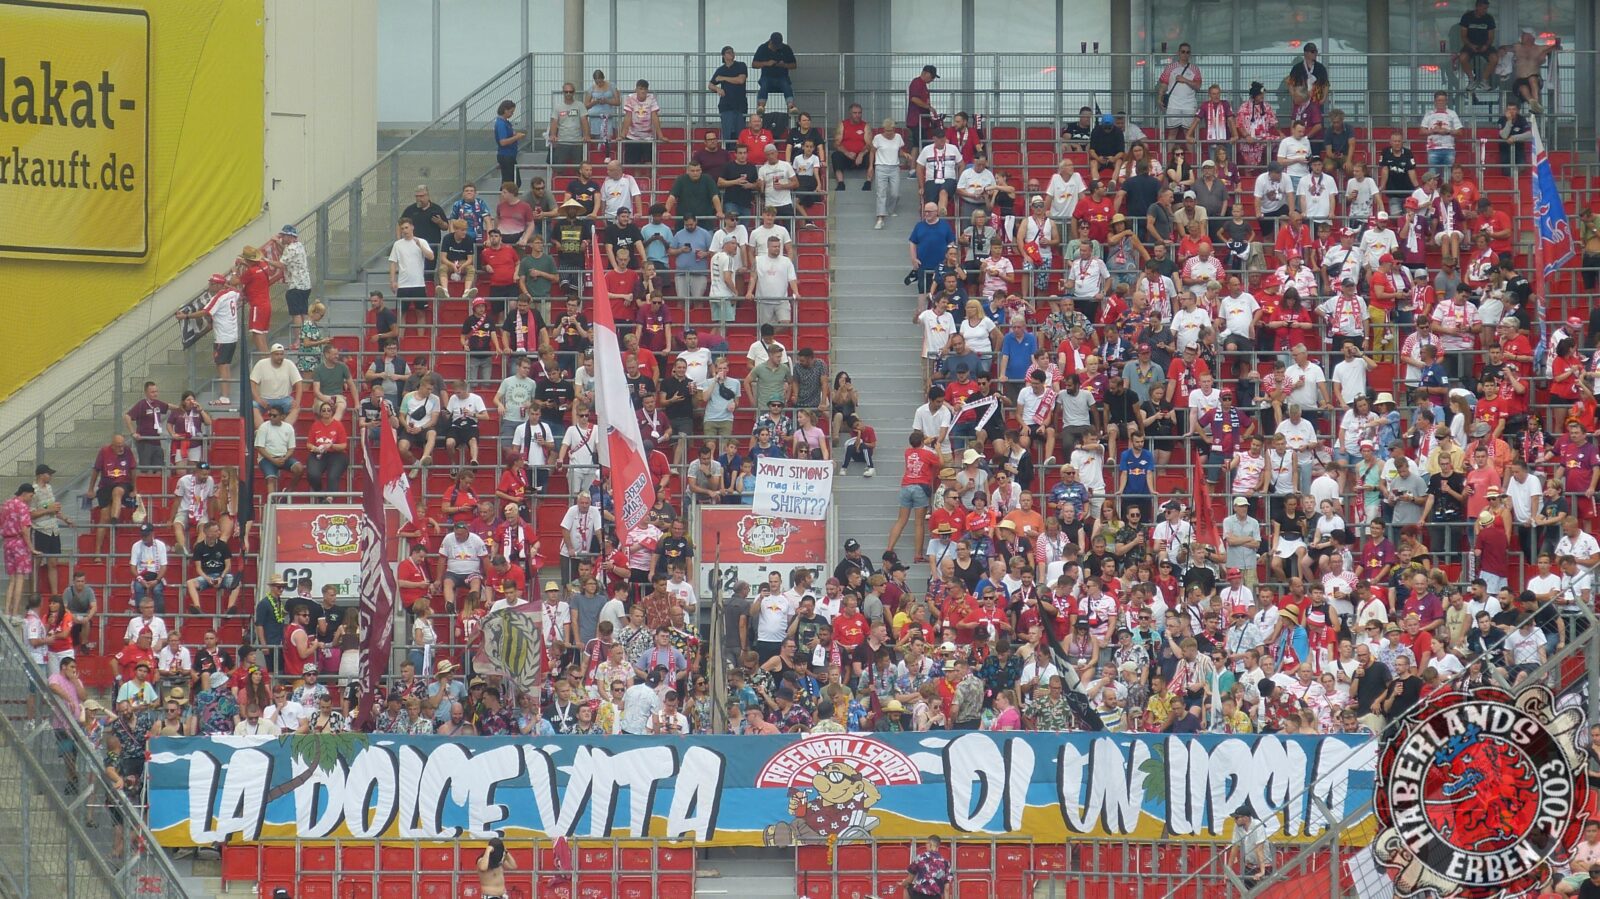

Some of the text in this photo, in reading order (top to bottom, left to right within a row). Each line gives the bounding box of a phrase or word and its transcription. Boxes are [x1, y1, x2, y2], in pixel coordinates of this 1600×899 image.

[758, 463, 829, 481] XAVI SIMONS
[767, 481, 815, 495] mag ik je
[771, 494, 826, 515] SHIRT??
[764, 738, 916, 784] RASENBALLSPORT
[189, 748, 273, 846] LA
[291, 742, 525, 840] DOLCE
[522, 744, 726, 844] VITA
[942, 732, 1035, 833] DI
[1057, 736, 1151, 835] UN
